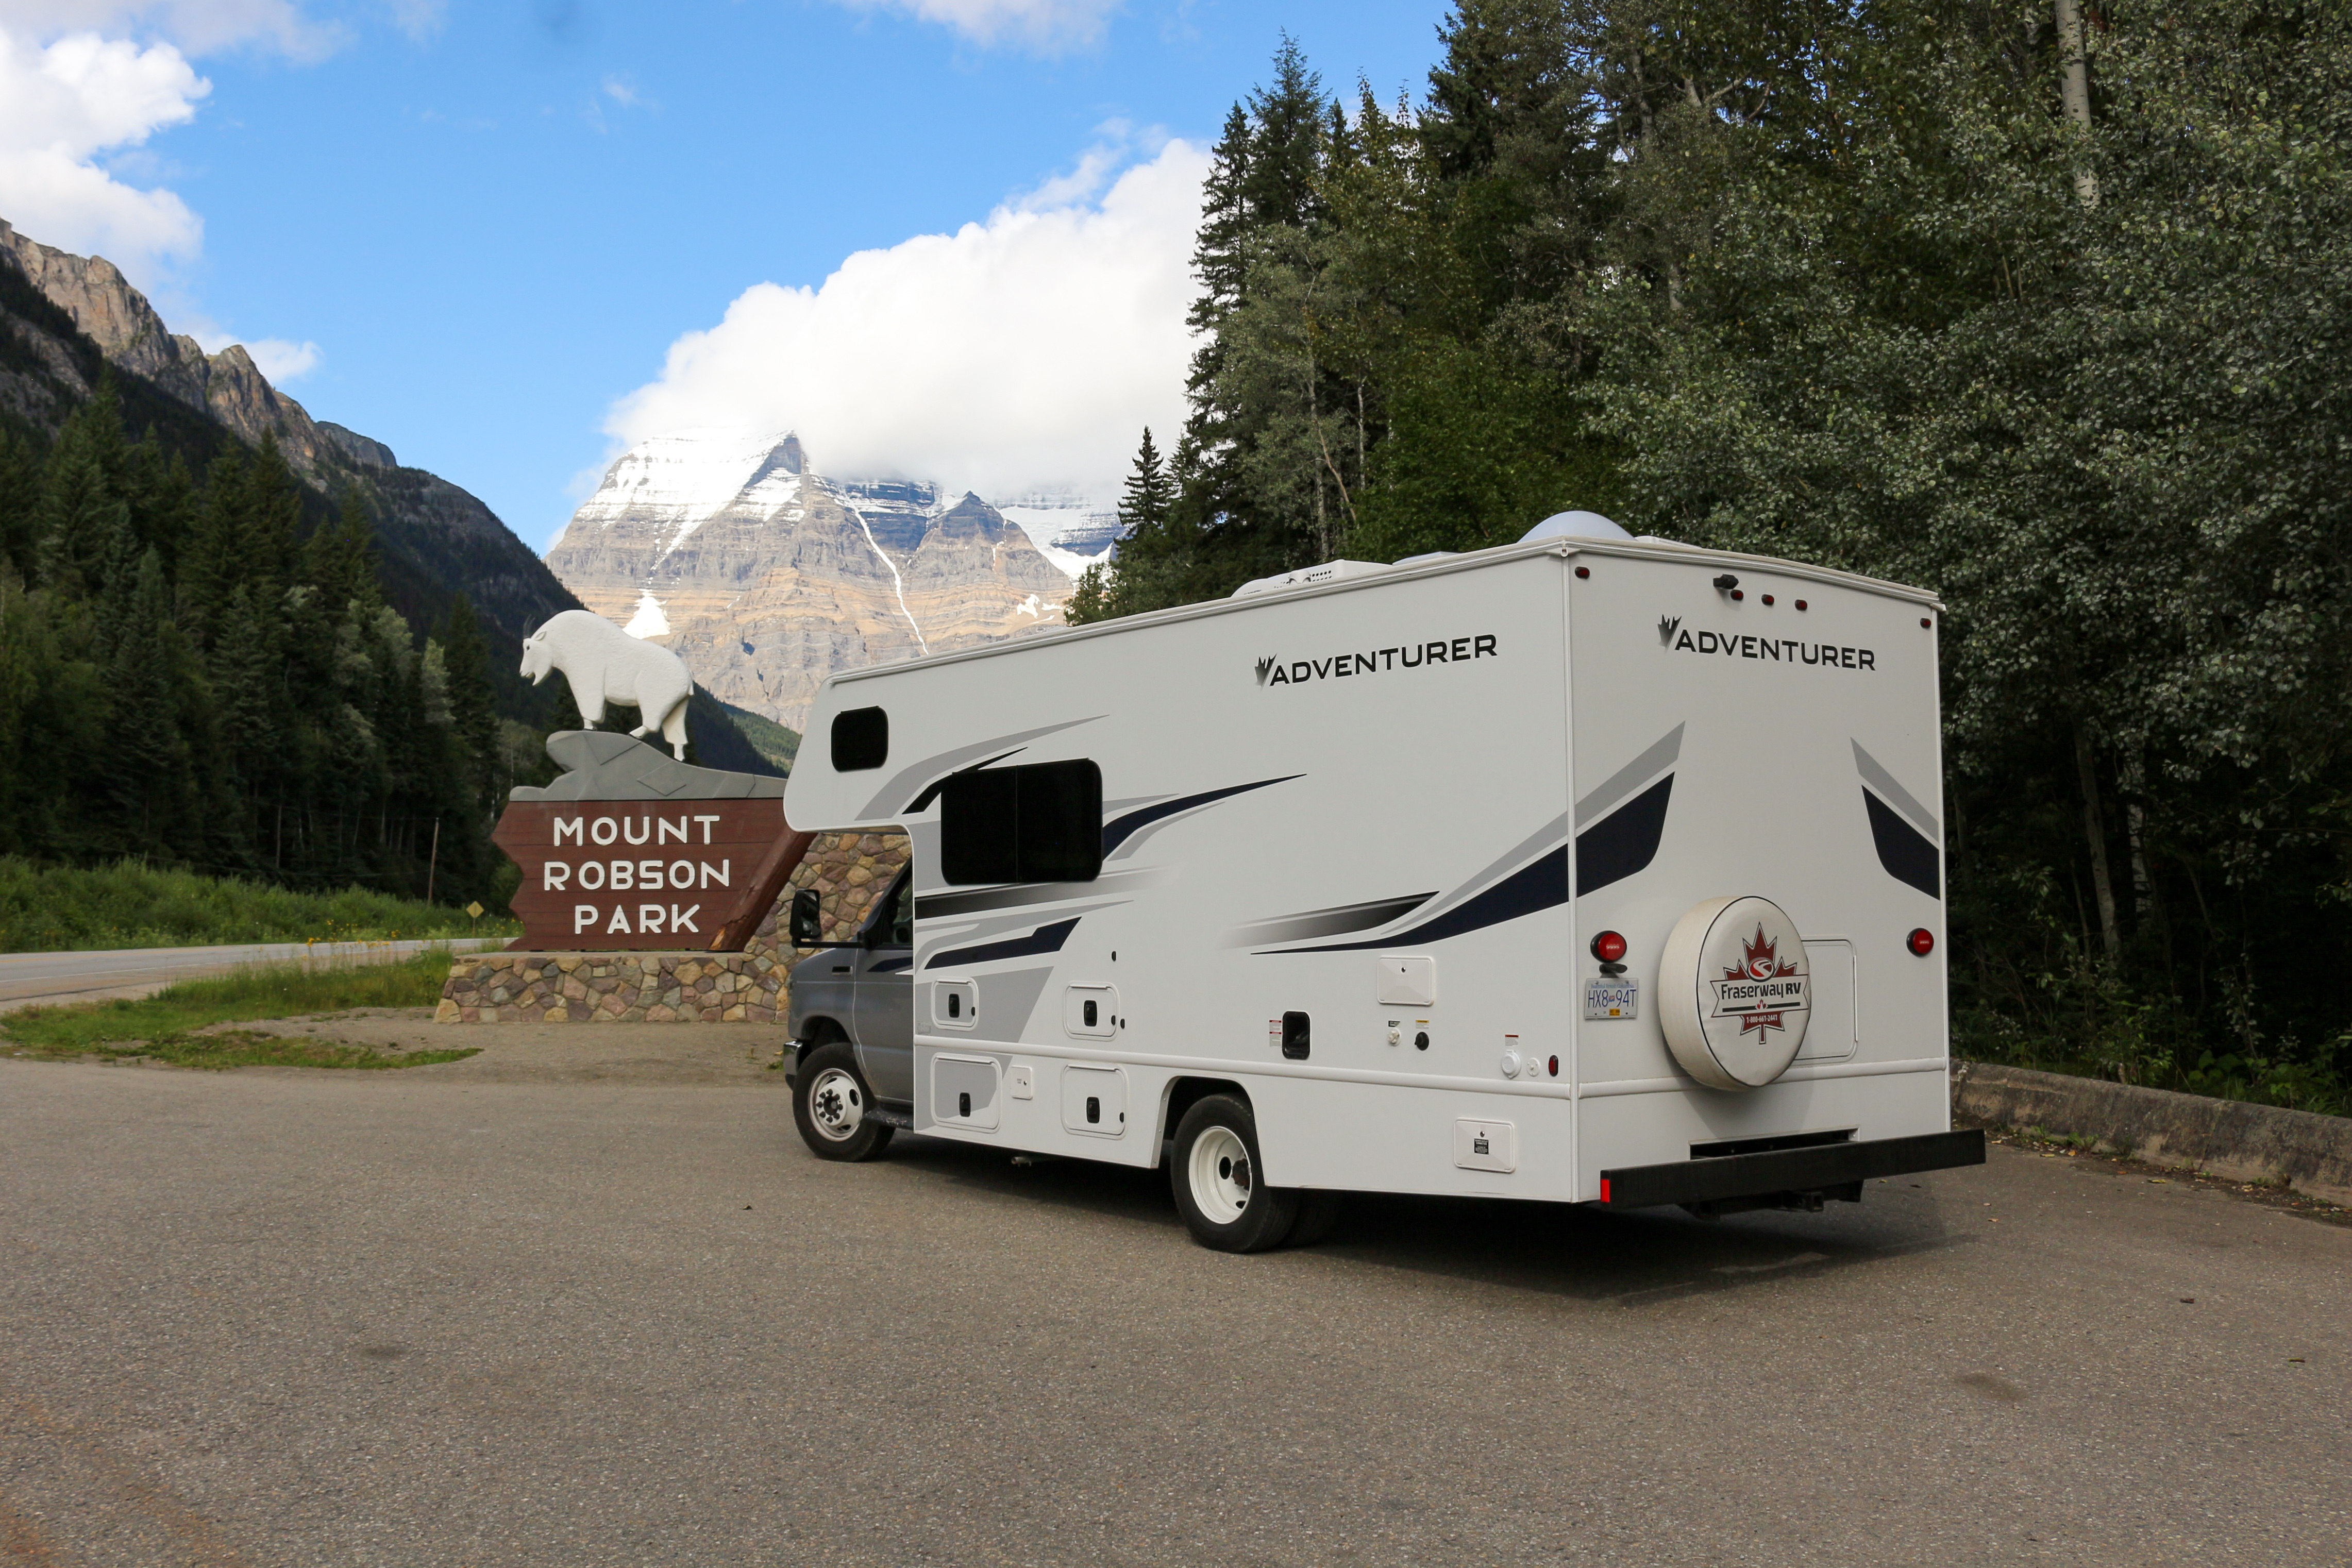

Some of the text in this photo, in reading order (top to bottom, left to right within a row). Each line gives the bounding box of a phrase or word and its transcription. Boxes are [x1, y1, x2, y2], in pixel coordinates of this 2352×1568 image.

[1269, 634, 1498, 687] ADVENTURER
[1675, 629, 1875, 671] ADVENTURER
[553, 815, 720, 846] MOUNT
[544, 859, 729, 890] ROBSON
[575, 904, 700, 934] PARK
[1721, 982, 1801, 1000] Fraserway RV
